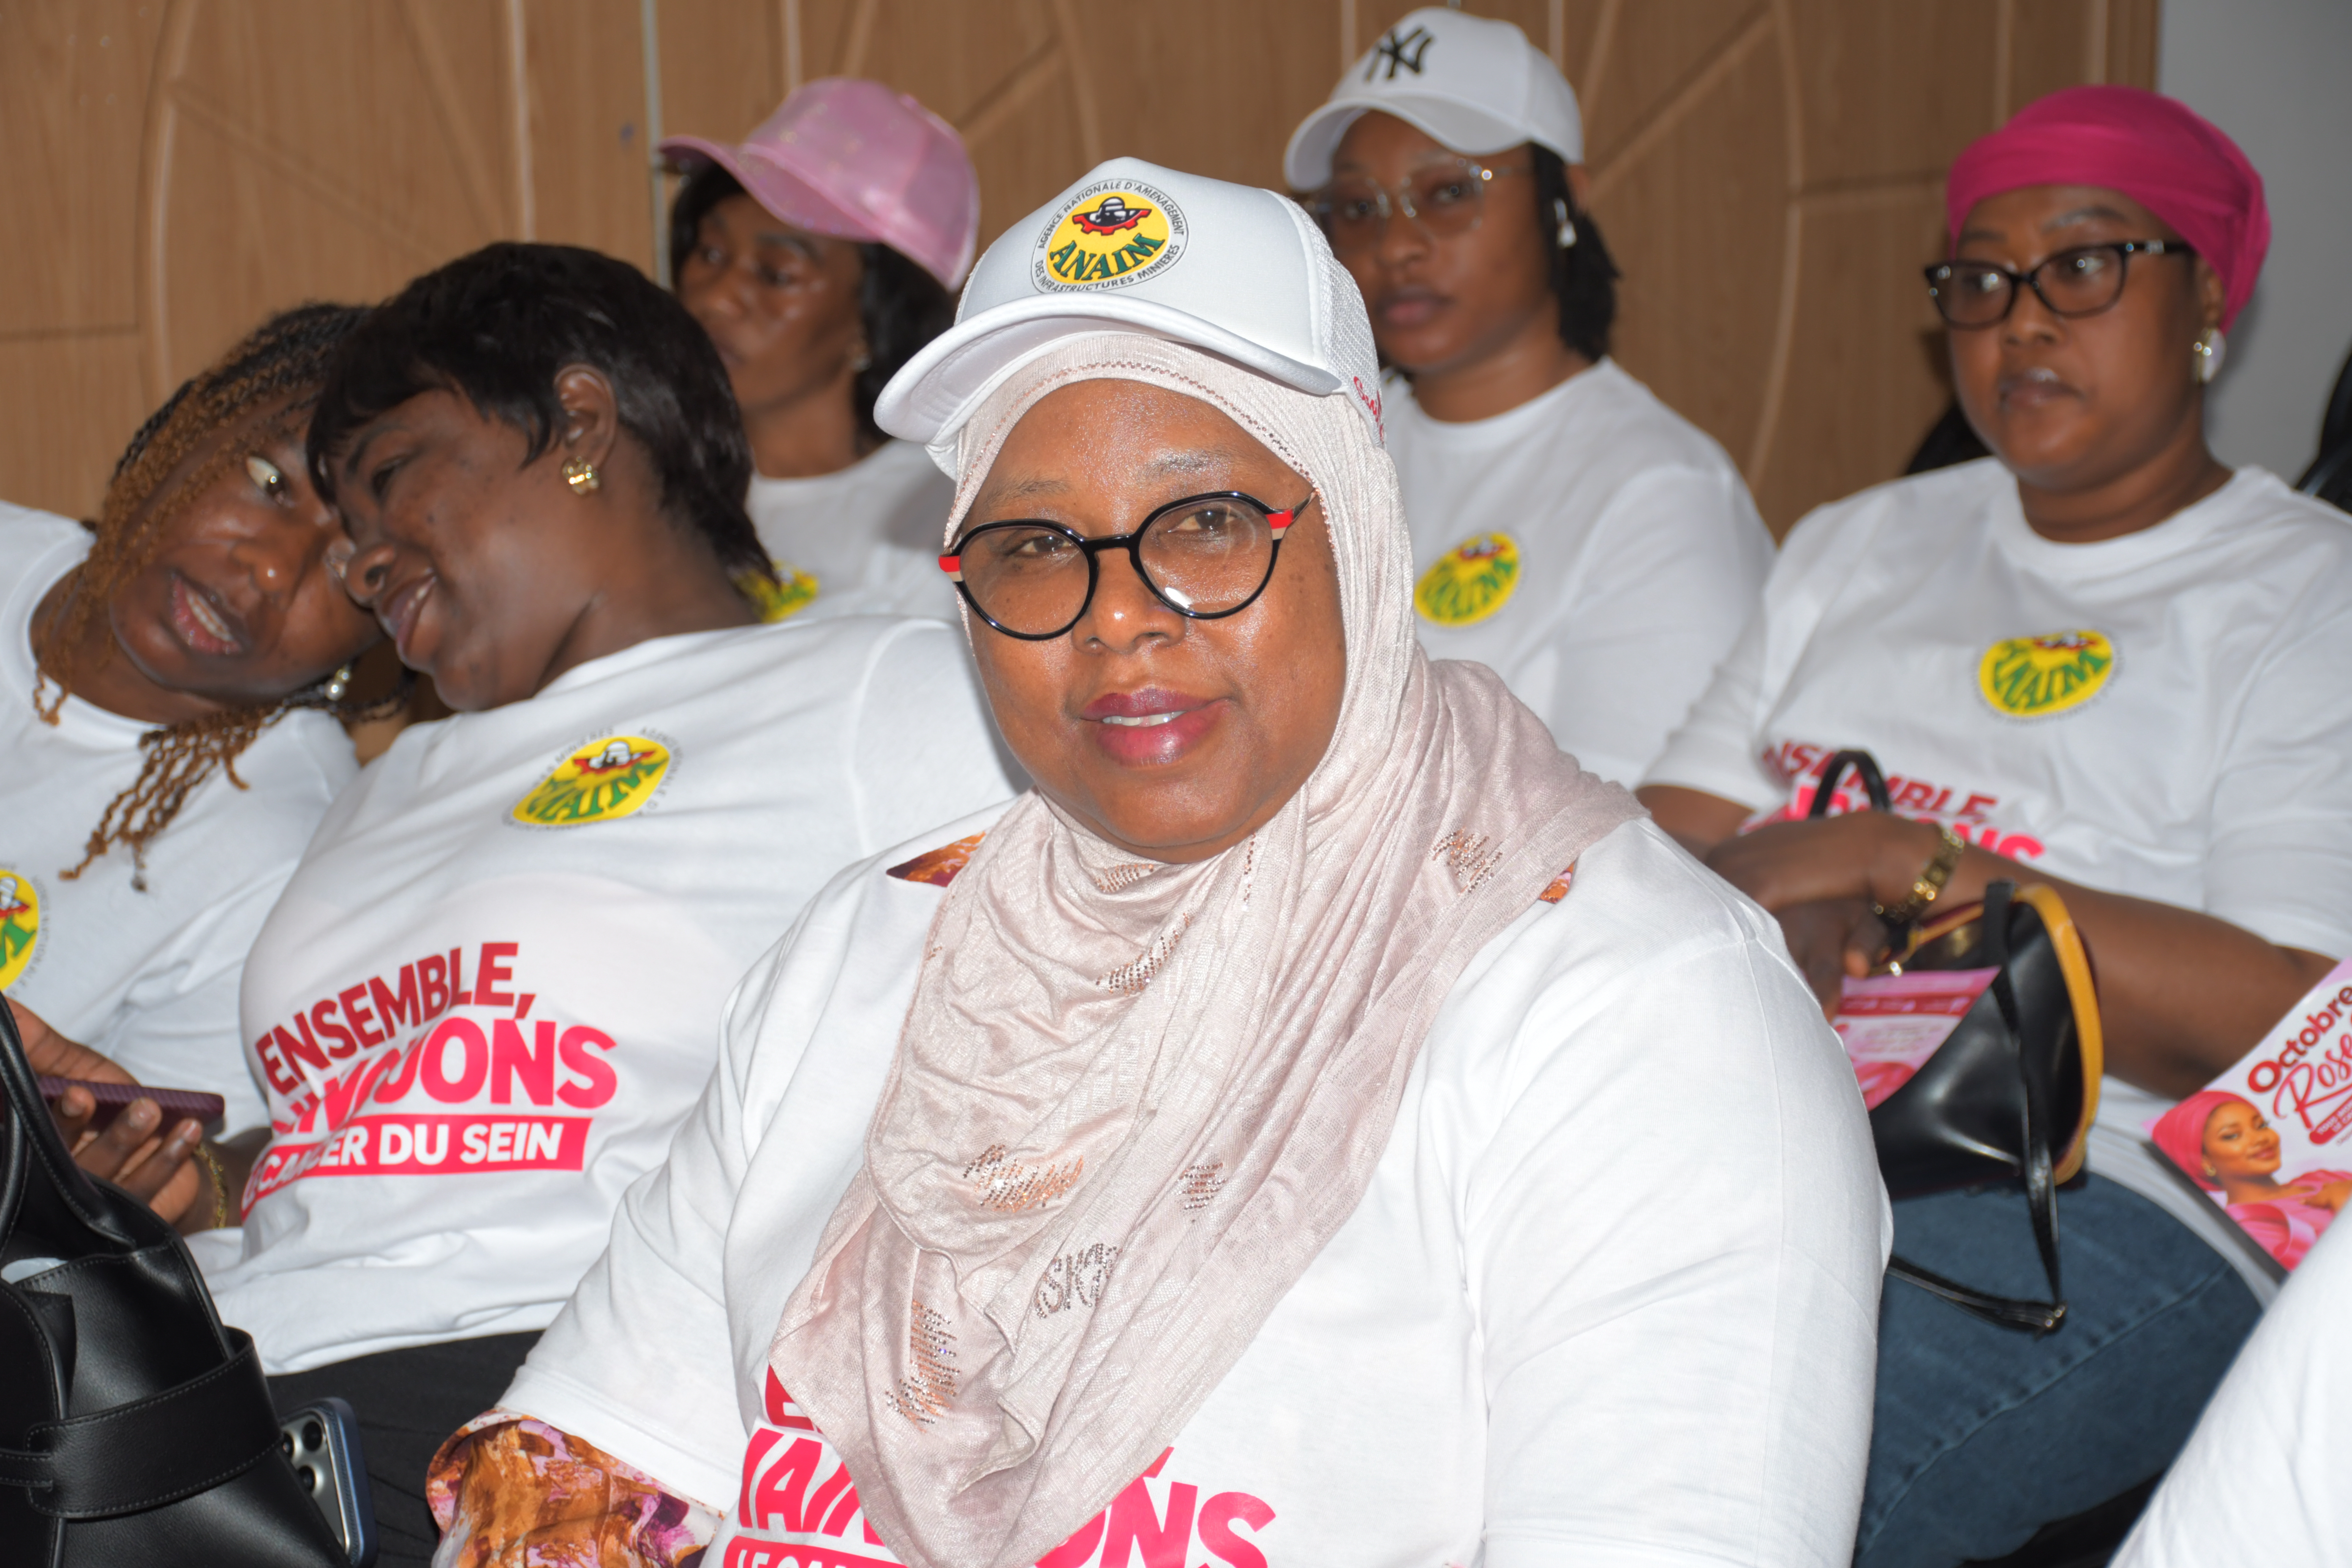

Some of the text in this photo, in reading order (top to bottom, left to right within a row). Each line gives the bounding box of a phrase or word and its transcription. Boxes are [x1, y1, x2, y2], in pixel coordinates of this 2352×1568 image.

[1037, 212, 1064, 249] AGENCE
[1063, 180, 1122, 213] NATIONALE
[1035, 244, 1180, 291] DES INFRASTRUCTURES MINIERES
[1050, 233, 1165, 280] ANAIM
[256, 942, 536, 1095] ENSEMBLE,
[2248, 986, 2352, 1093] Octobre
[379, 1124, 450, 1165] DU
[460, 1122, 564, 1164] SEIN
